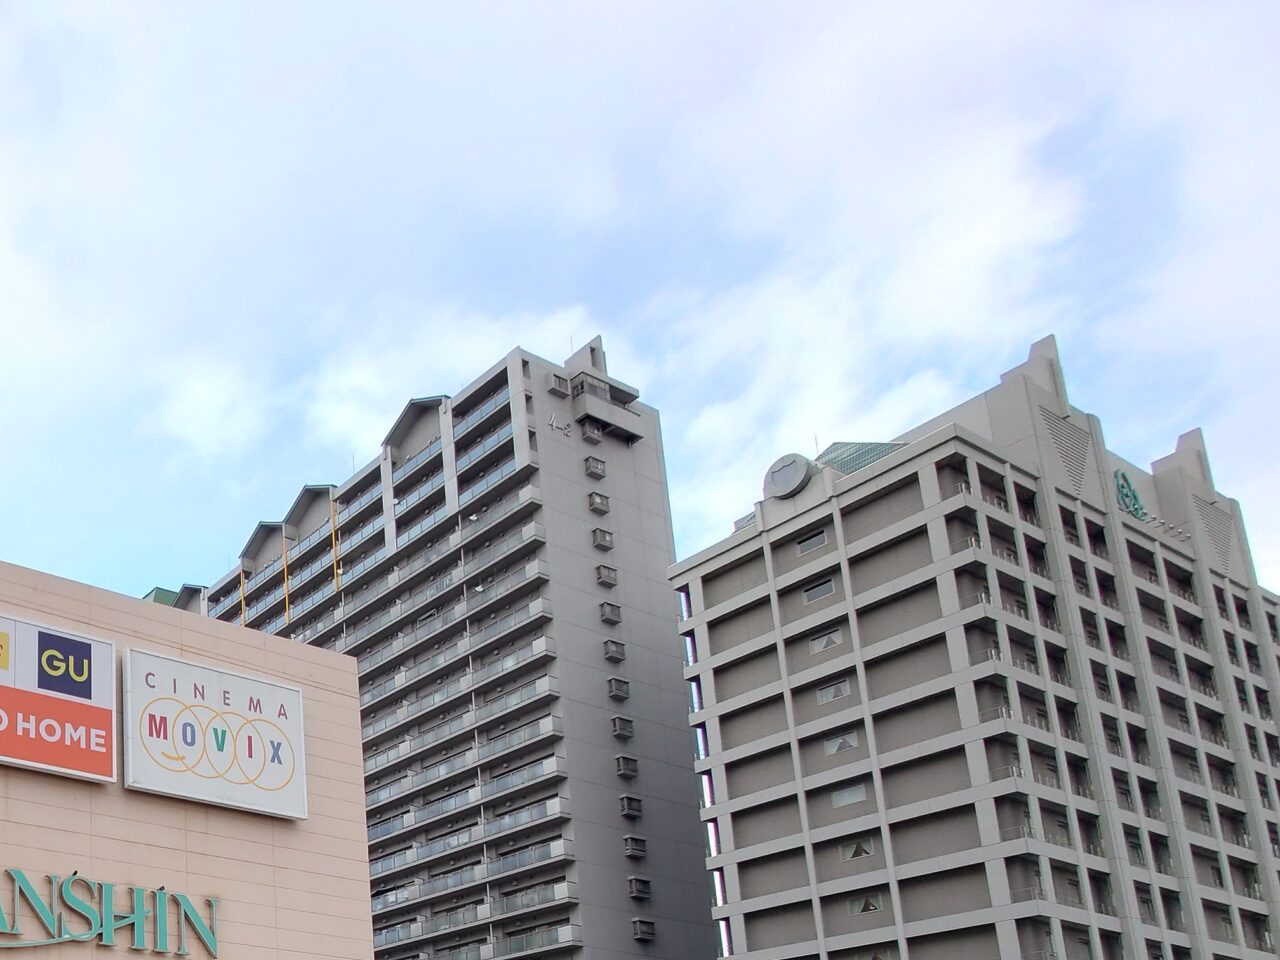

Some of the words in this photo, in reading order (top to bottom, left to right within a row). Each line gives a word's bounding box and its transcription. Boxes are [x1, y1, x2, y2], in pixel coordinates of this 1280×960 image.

[41, 649, 89, 682] GU
[144, 672, 288, 720] CINEMA
[16, 712, 107, 753] HOME
[148, 713, 282, 765] MOVIX
